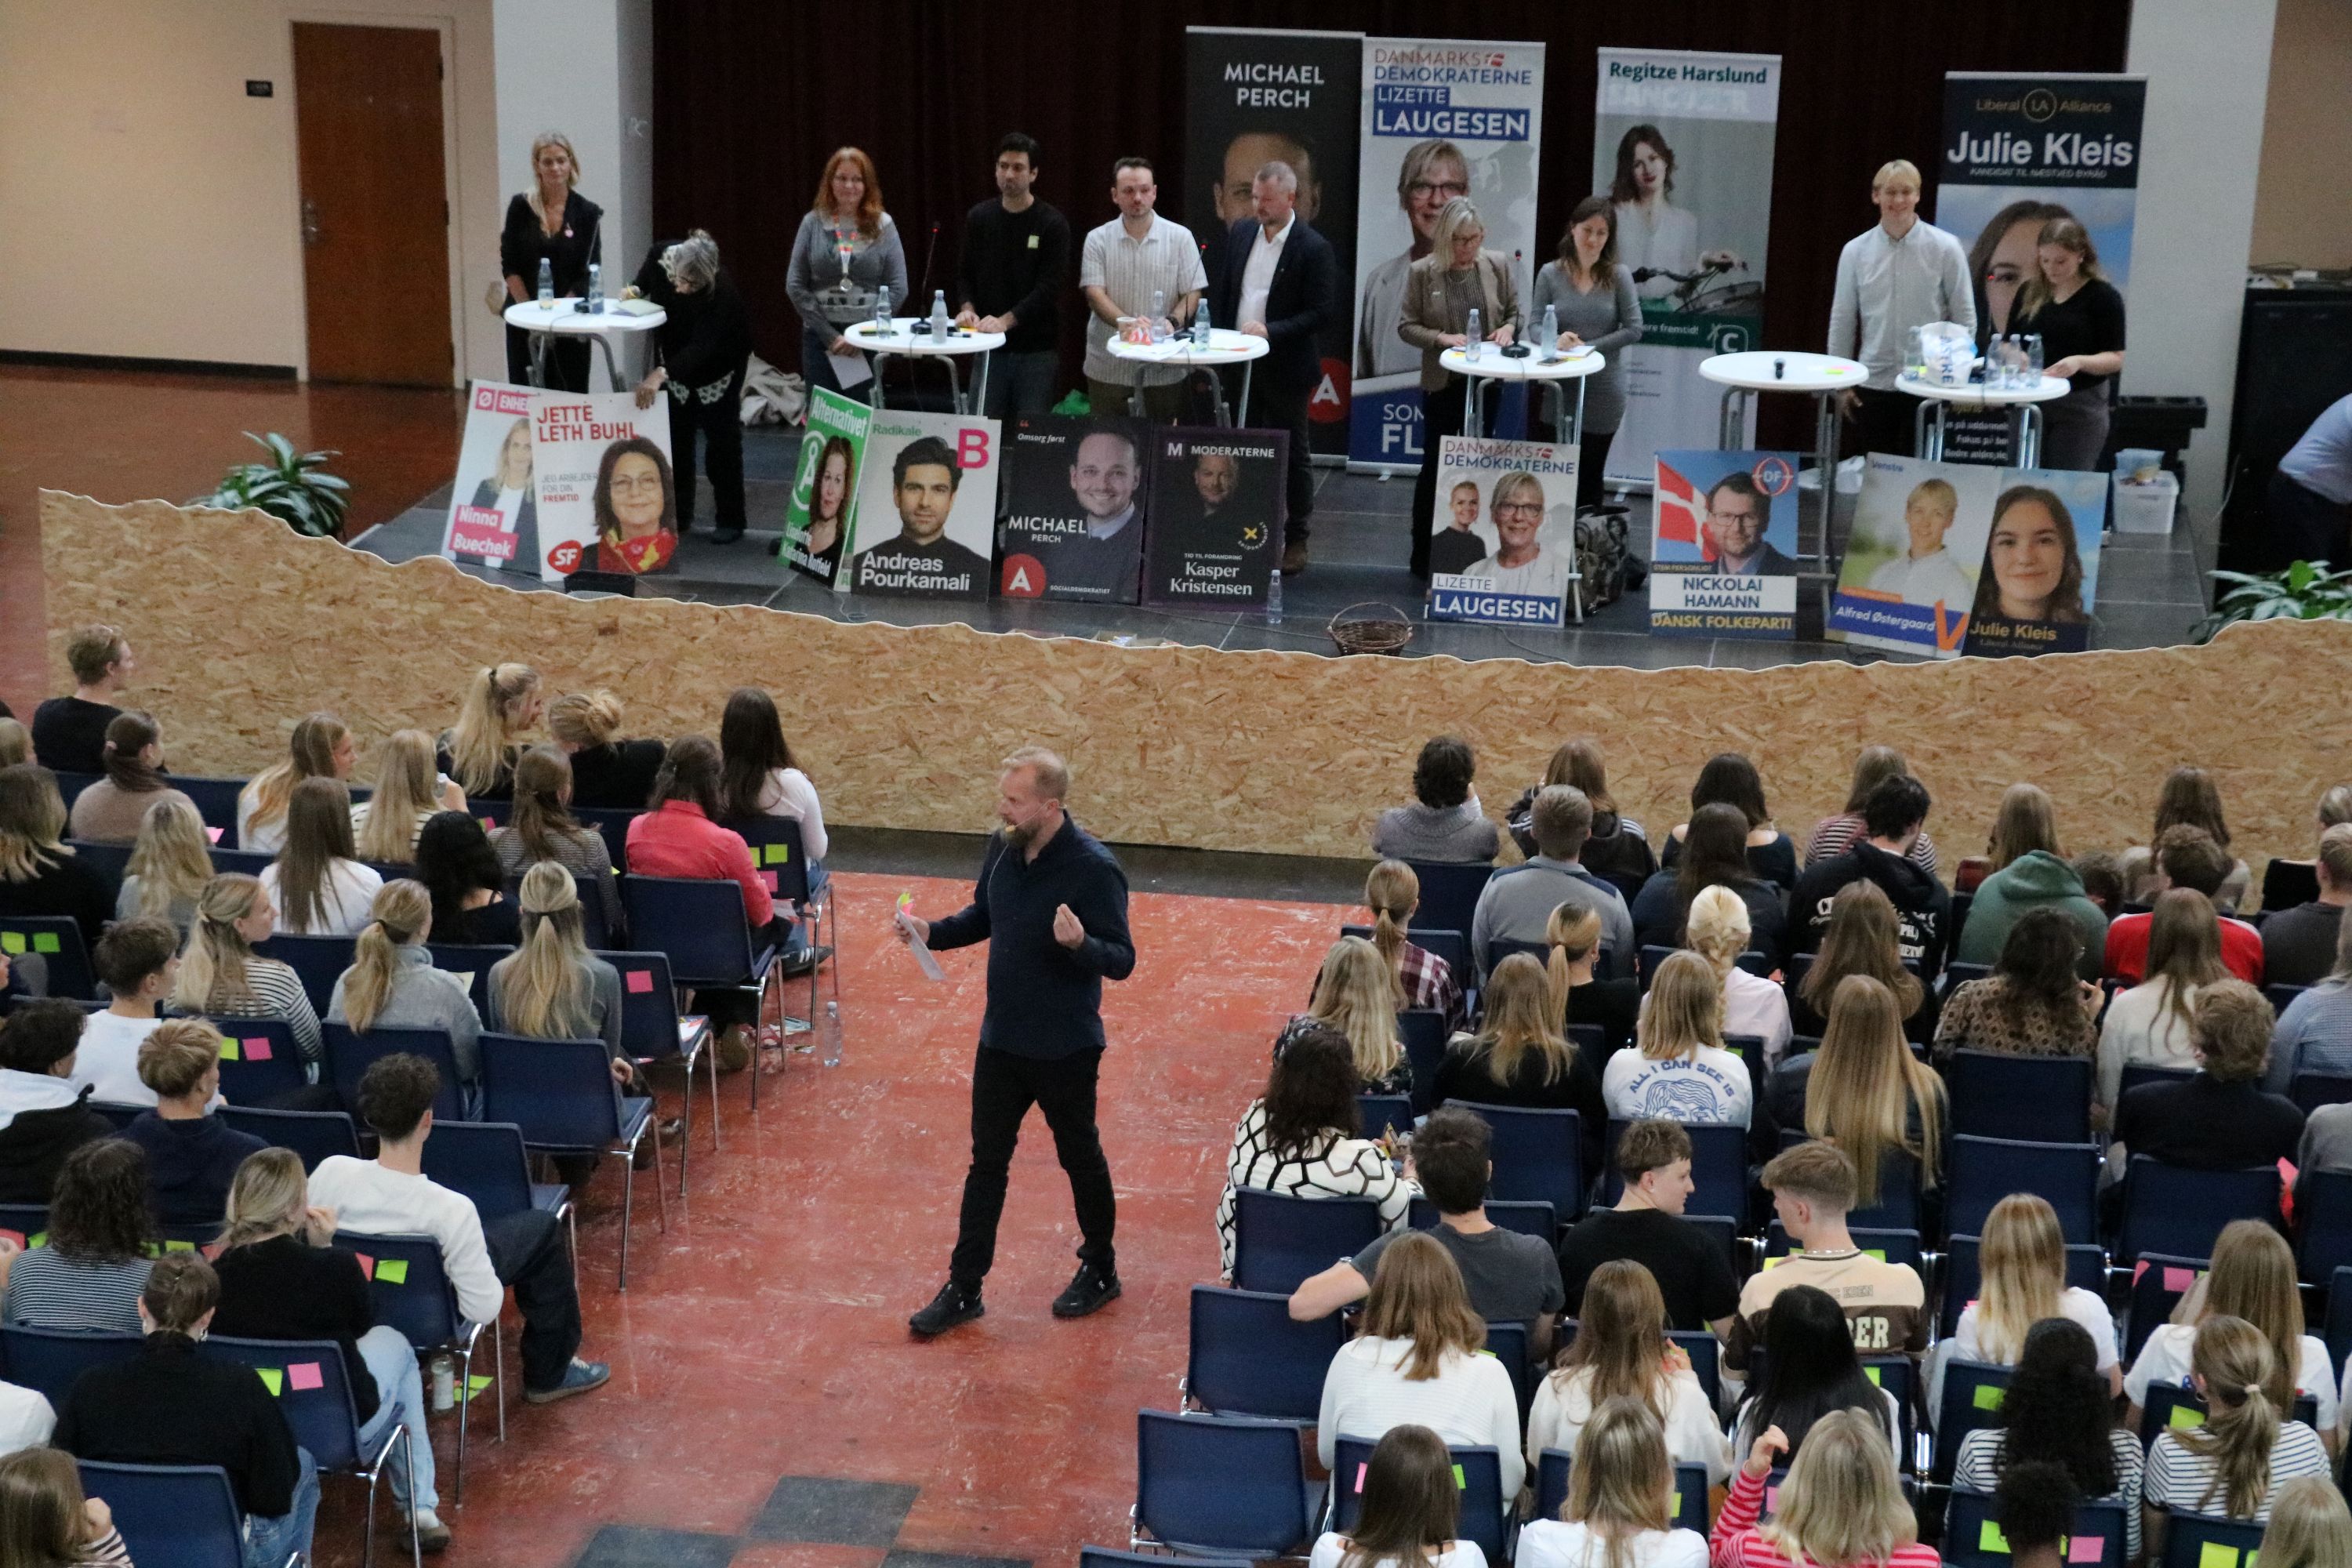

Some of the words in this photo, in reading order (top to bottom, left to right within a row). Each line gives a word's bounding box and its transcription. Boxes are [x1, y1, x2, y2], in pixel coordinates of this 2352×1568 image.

[1375, 48, 1481, 67] DANMARKS
[1225, 63, 1324, 85] MICHAEL
[1374, 66, 1532, 85] DEMOKRATERNE
[1610, 62, 1677, 82] Regitze
[1682, 65, 1767, 83] Harslund
[1236, 88, 1310, 108] PERCH
[1377, 88, 1446, 104] LIZETTE
[1976, 99, 2020, 111] Liberal
[2060, 100, 2112, 113] Alliance
[1377, 110, 1526, 136] LAUGESEN
[1947, 131, 2032, 165] Julie
[2044, 132, 2133, 166] Kleis
[1722, 332, 1738, 353] C
[1312, 373, 1341, 405] A
[537, 405, 593, 423] JETTE
[811, 395, 867, 438] Alternativet
[539, 424, 583, 442] LETH
[590, 422, 640, 440] BUHL
[872, 423, 922, 436] Radikale
[1018, 433, 1046, 444] Omsorg
[1047, 434, 1066, 444] først
[956, 428, 989, 469] B
[1167, 442, 1182, 456] M
[1191, 445, 1275, 458] MODERATERNE
[1445, 440, 1534, 458] DANMARKS
[1444, 453, 1575, 475] DEMOKRATERNE
[1763, 470, 1783, 481] DF
[459, 506, 499, 527] Ninna
[1008, 515, 1087, 533] MICHAEL
[452, 532, 511, 557] Buechek
[1032, 534, 1062, 543] PERCH
[555, 548, 578, 568] SF
[862, 551, 943, 572] Andreas
[1009, 566, 1032, 591] A
[1185, 561, 1240, 580] Kasper
[861, 571, 971, 591] Pourkamali
[1050, 585, 1110, 594] SOCIALDEMOKRATIET
[1171, 578, 1253, 595] Kristensen
[1437, 576, 1492, 590] LIZETTE
[1683, 577, 1762, 591] NICKOLAI
[1435, 594, 1556, 620] LAUGESEN
[1685, 593, 1760, 608] HAMANN
[1651, 614, 1703, 628] DANSK
[1705, 615, 1792, 630] FOLKEPARTI
[1835, 606, 1871, 621] Alfred
[1871, 612, 1936, 632] Østergaard
[1969, 620, 2009, 637] Julie
[2014, 624, 2057, 641] Kleis
[1629, 1071, 1652, 1094] ALL
[1650, 1065, 1659, 1074] I
[1661, 1060, 1692, 1071] CAN
[1696, 1063, 1724, 1083] SEE
[1722, 1083, 1735, 1098] IS
